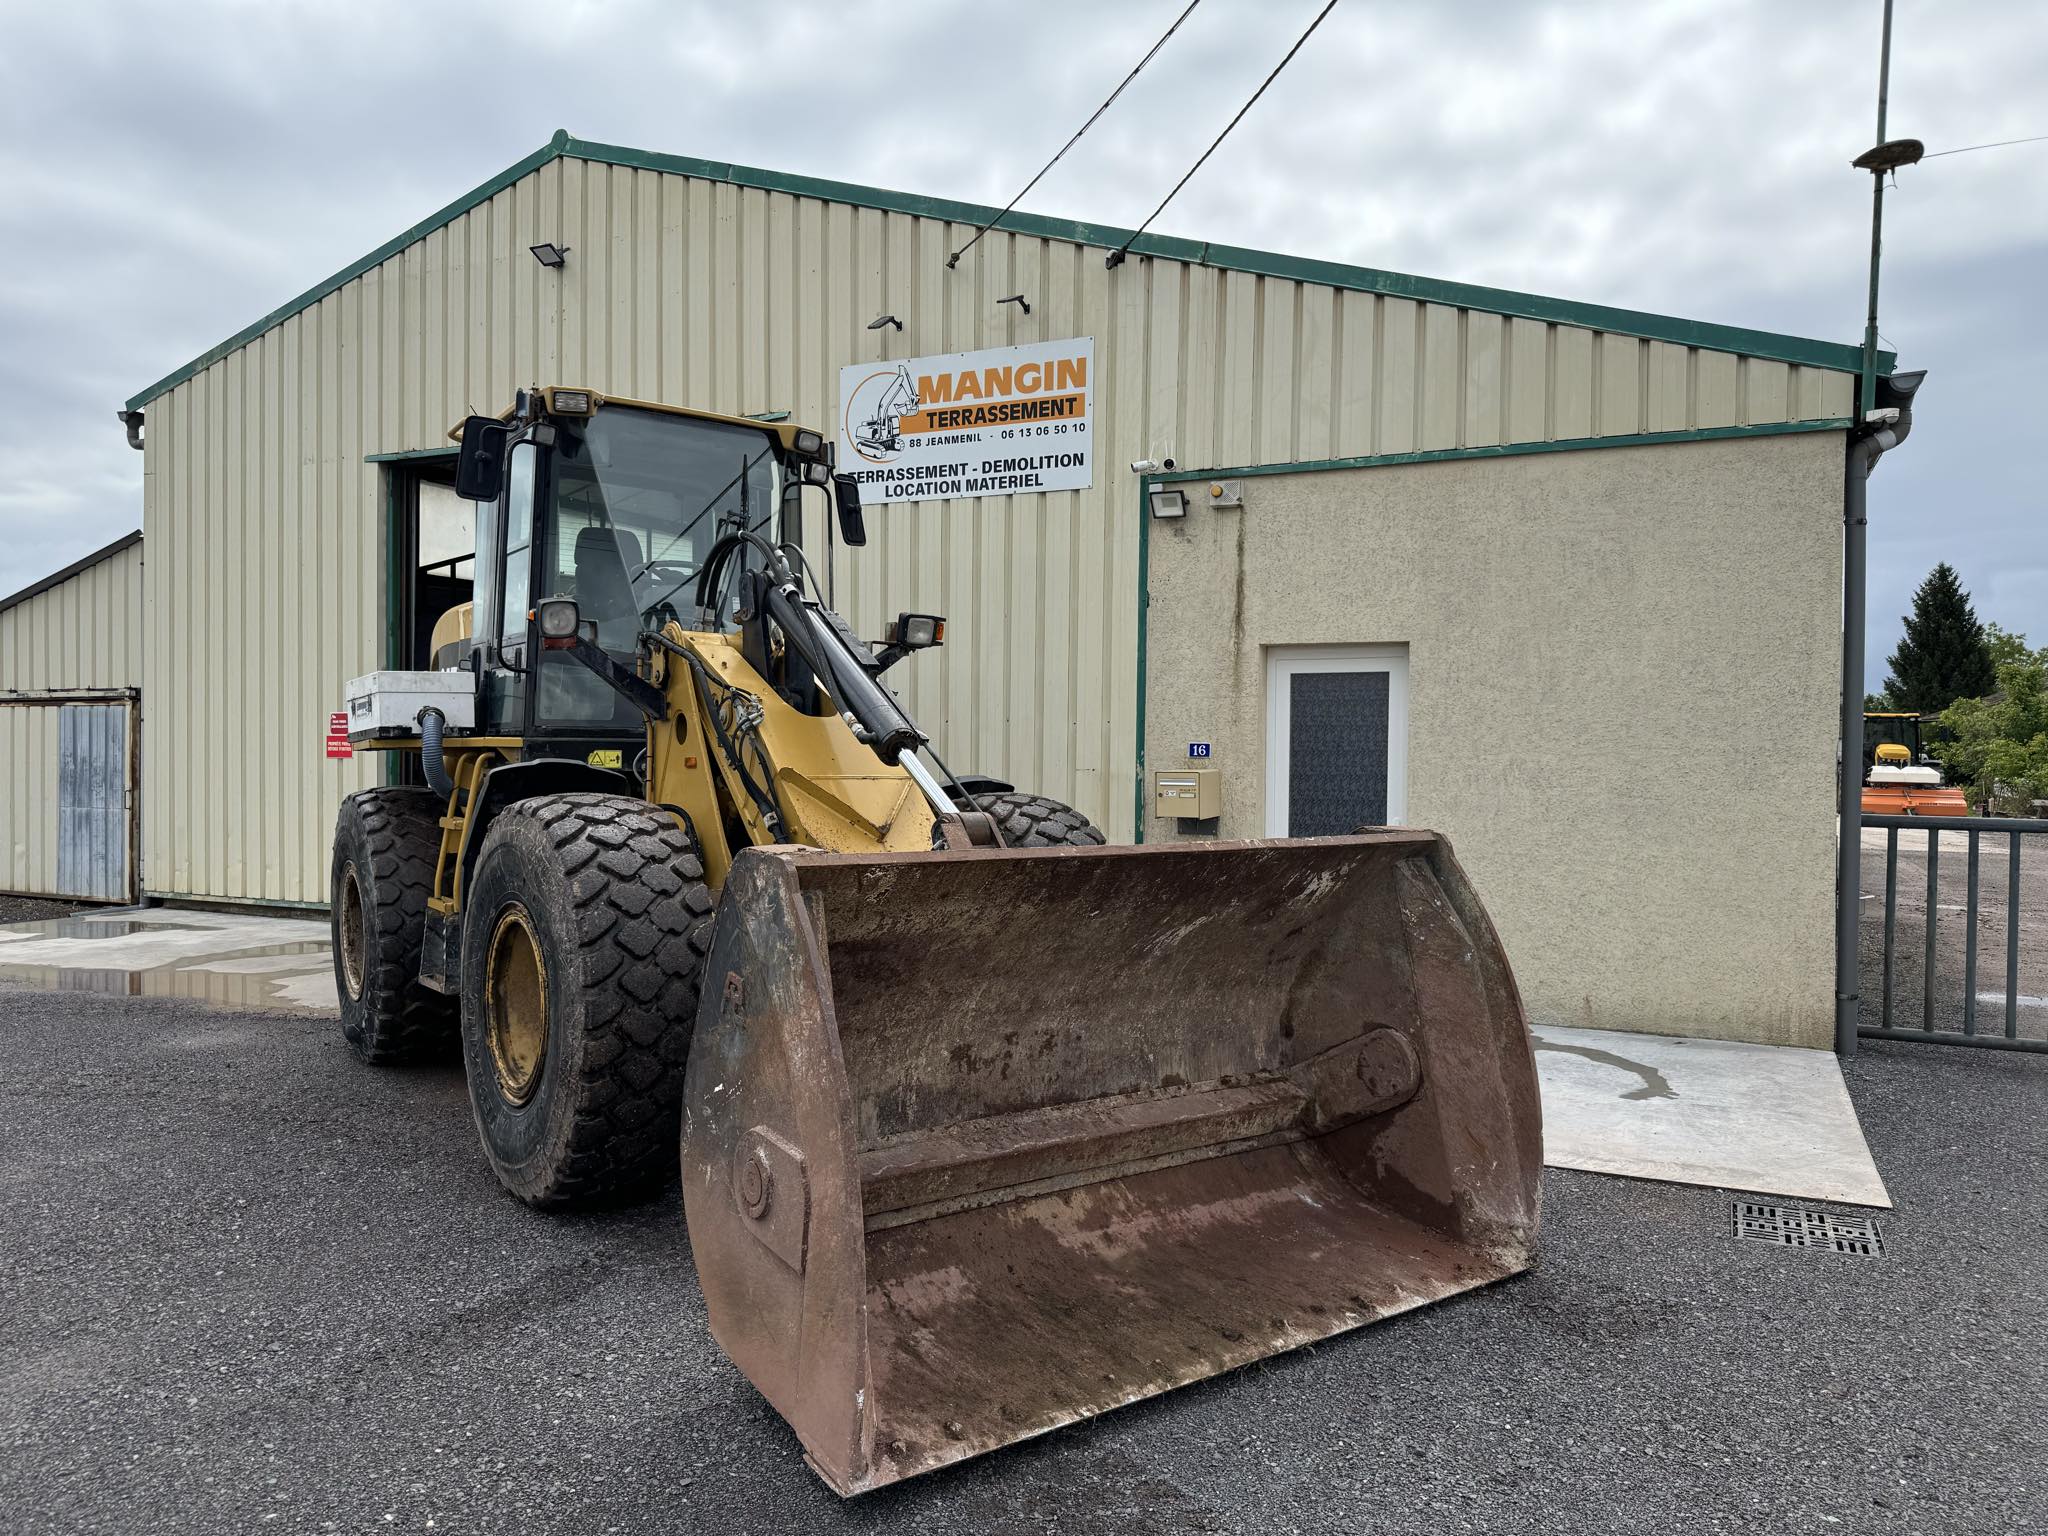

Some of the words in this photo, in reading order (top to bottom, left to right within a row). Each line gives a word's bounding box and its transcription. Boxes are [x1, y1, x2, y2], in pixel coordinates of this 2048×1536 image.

[918, 357, 1087, 405] MANGIN
[926, 397, 1078, 429] TERRASSEMENT
[909, 438, 922, 448] 88
[926, 433, 982, 447] JEANMENIL
[1001, 429, 1014, 440] 06
[1018, 427, 1031, 438] 13
[1035, 425, 1050, 436] 06
[1054, 424, 1068, 435] 50
[1072, 422, 1086, 433] 10
[982, 452, 1085, 474] DEMOLITION
[885, 479, 962, 498] LOCATION
[965, 473, 1044, 492] MATERIEL
[1193, 744, 1206, 756] 16
